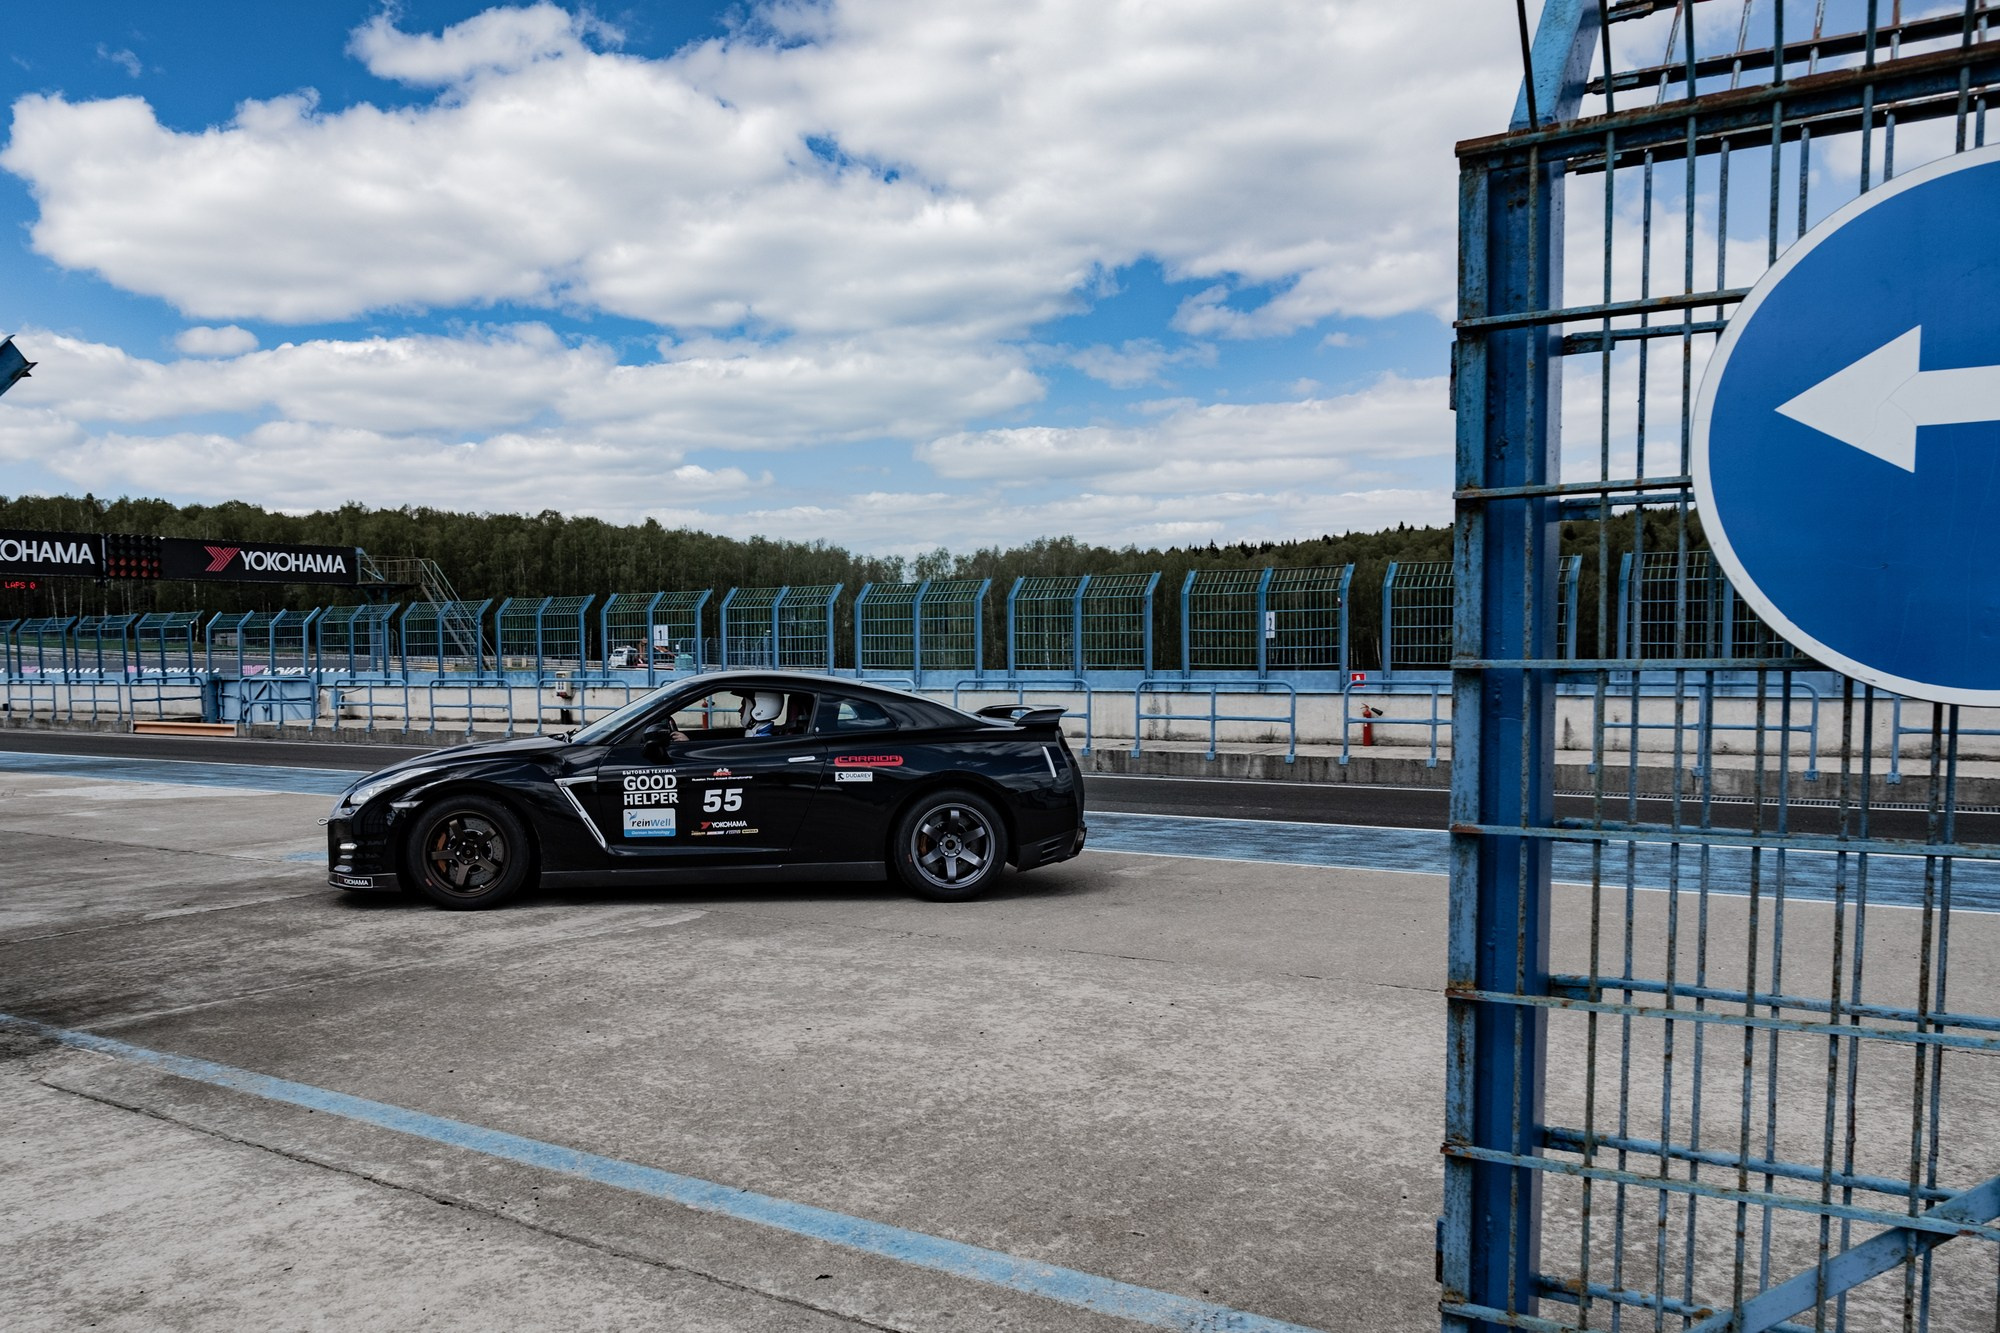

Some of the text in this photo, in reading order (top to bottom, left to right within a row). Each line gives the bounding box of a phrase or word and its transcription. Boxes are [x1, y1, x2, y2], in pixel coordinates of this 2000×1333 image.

[0, 539, 95, 564] OHAMA
[240, 551, 346, 573] YOKOHAMA
[5, 581, 26, 589] LAPS
[658, 630, 663, 641] 1
[623, 775, 677, 790] GOOD
[623, 793, 679, 806] HELPER
[702, 788, 743, 812] 55
[631, 818, 671, 828] reinWell
[711, 820, 747, 828] YOKOHAMA
